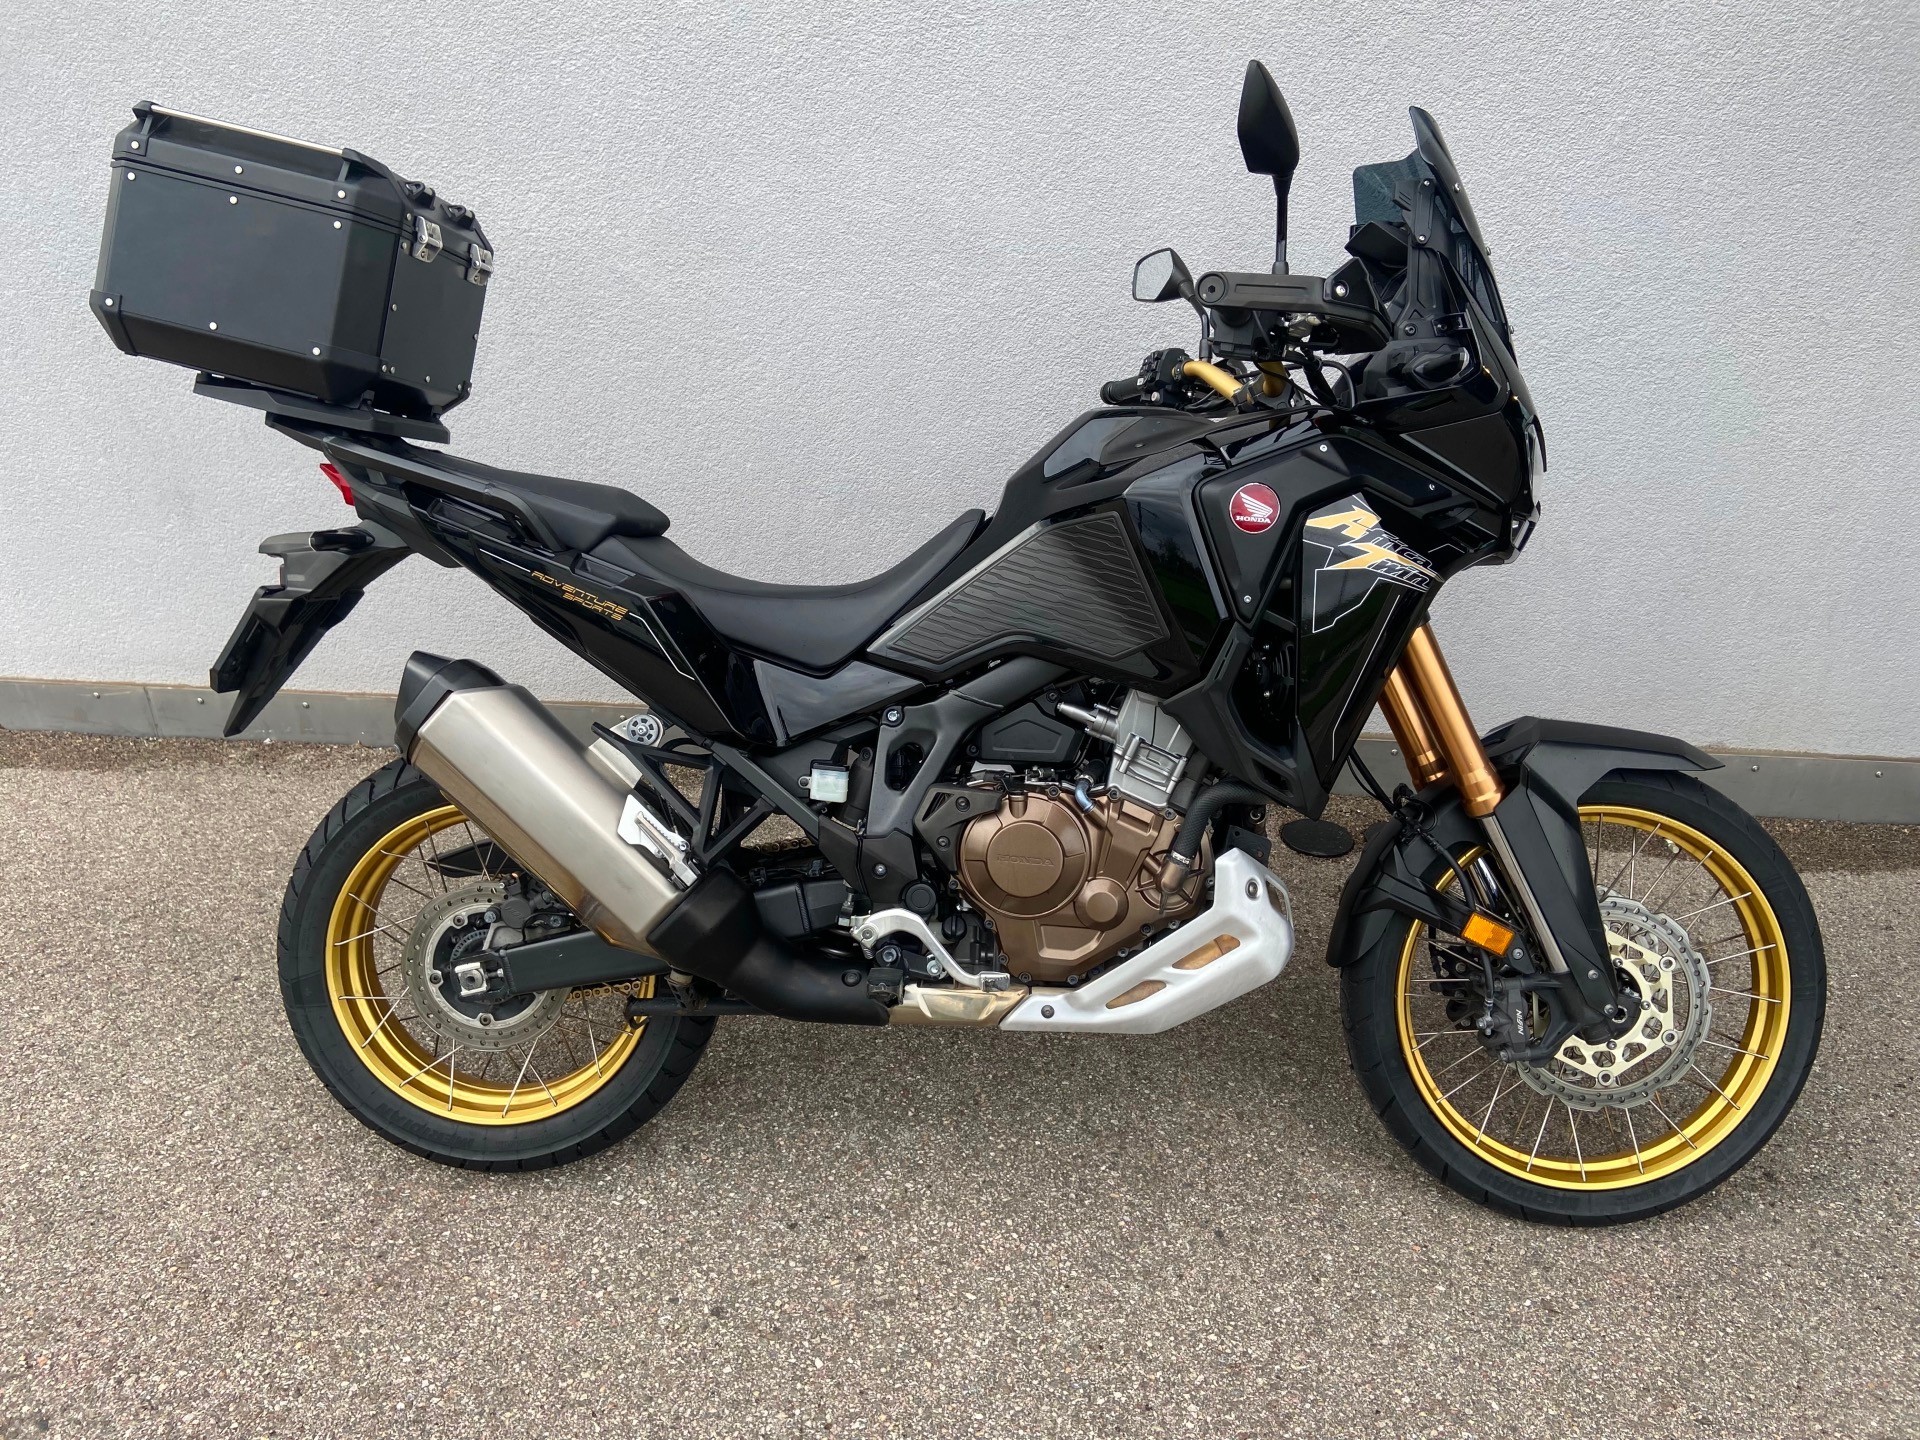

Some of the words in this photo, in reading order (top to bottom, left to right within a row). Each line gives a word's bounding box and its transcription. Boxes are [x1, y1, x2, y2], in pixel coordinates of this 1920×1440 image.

[1235, 515, 1272, 524] HONDA
[531, 570, 629, 615] ADVENTURE
[562, 592, 624, 621] SPORTS
[996, 853, 1055, 867] HONDA
